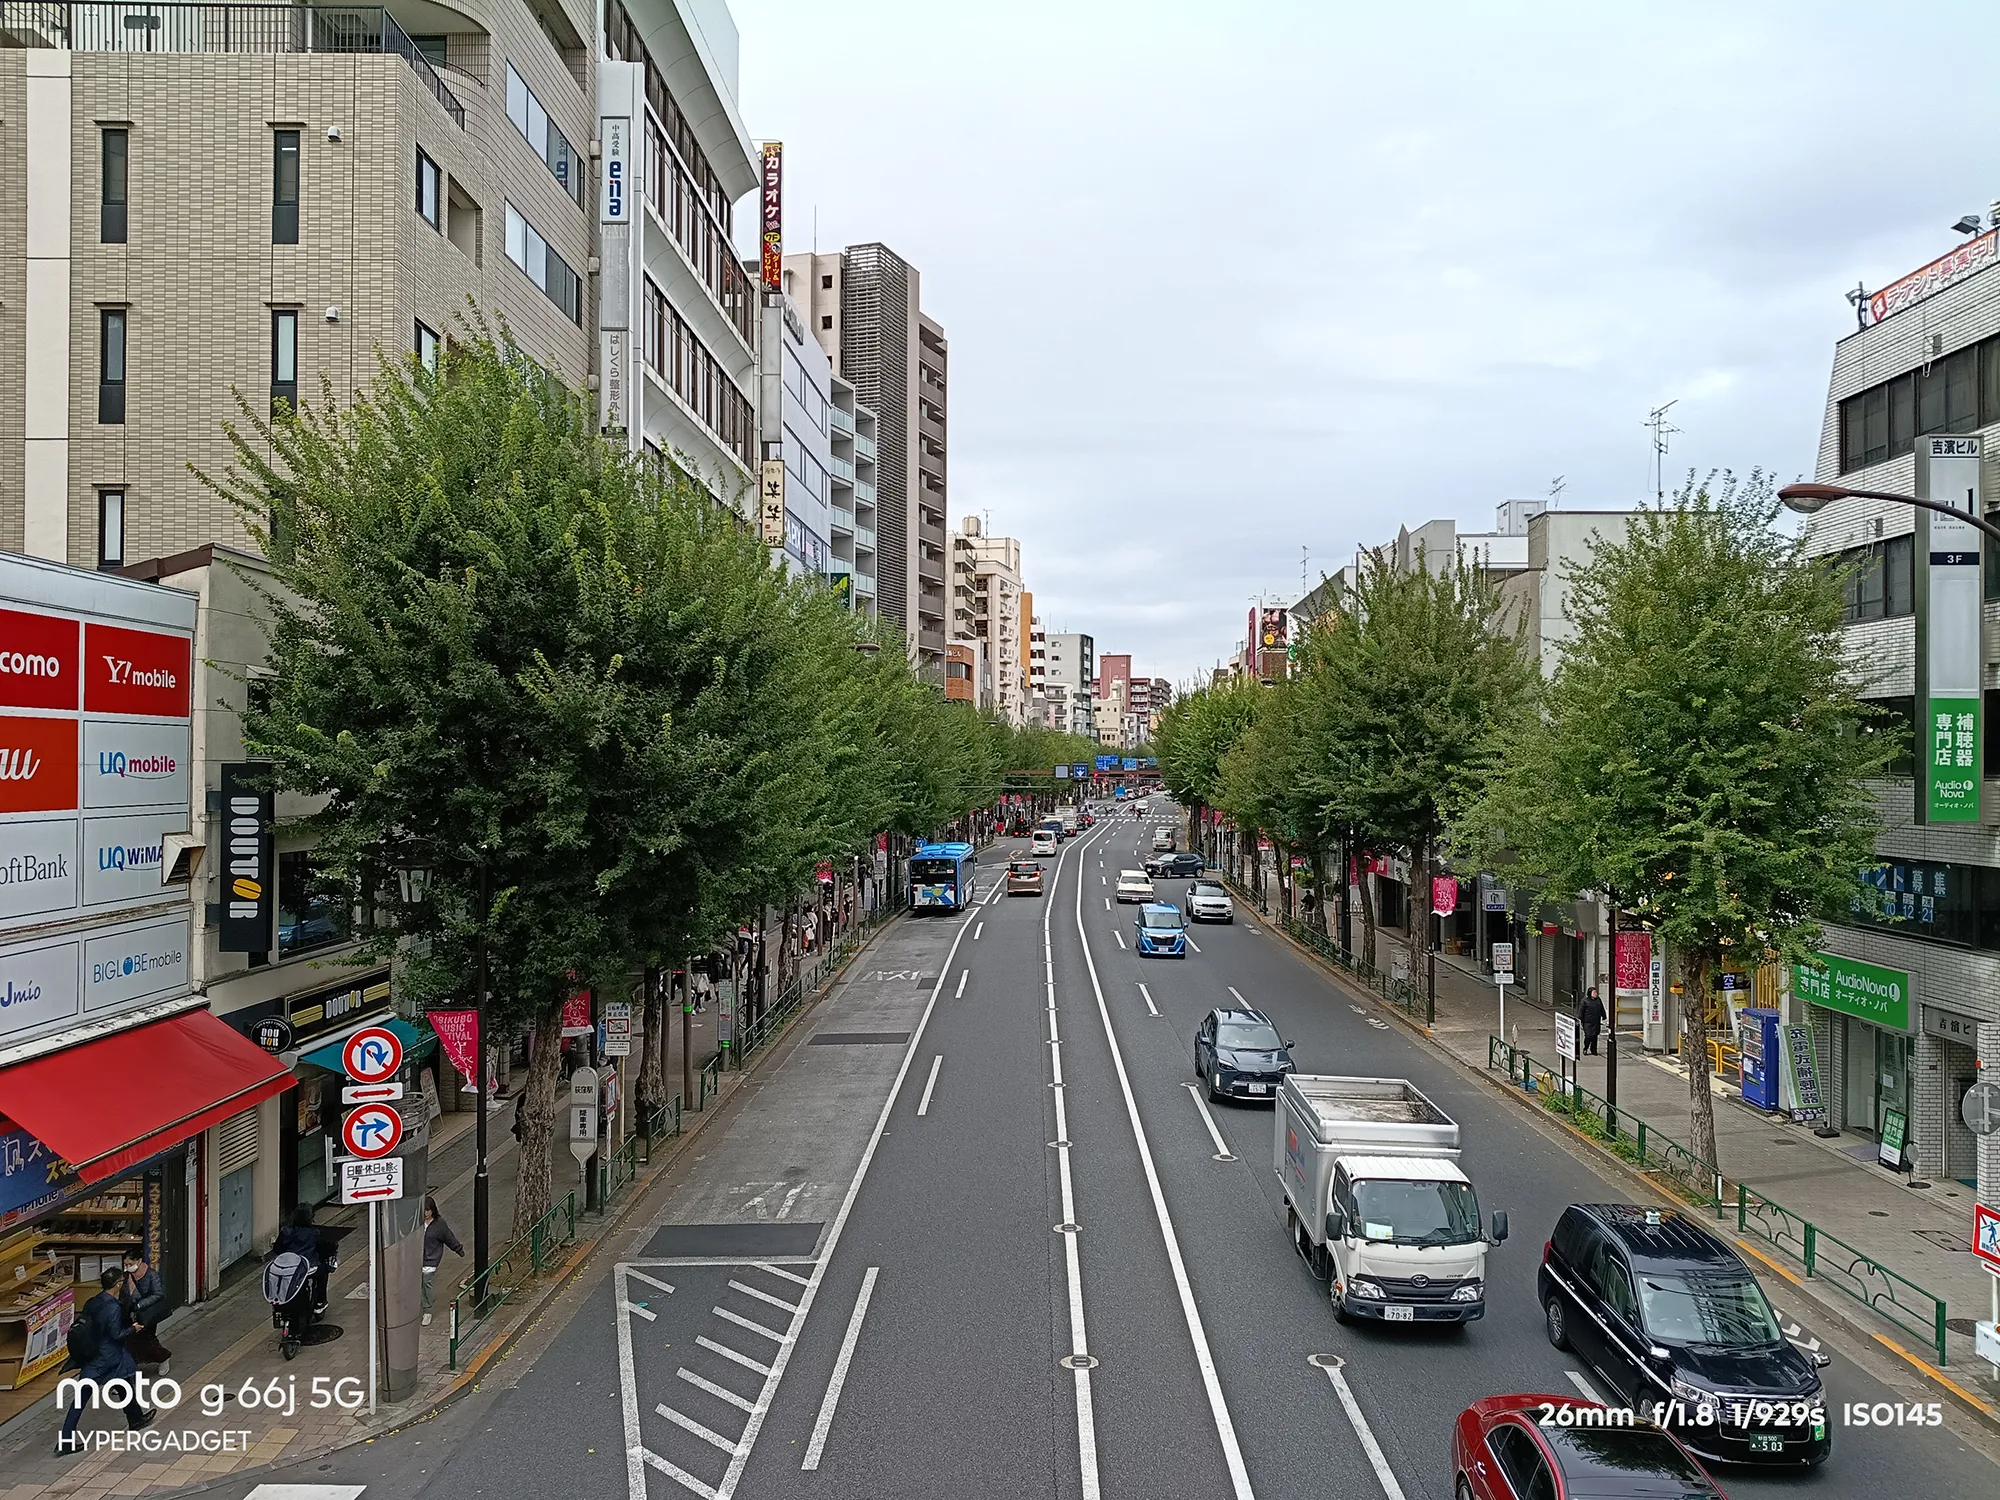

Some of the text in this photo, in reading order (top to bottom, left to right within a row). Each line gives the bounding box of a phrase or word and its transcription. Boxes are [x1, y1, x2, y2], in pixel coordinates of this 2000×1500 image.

[609, 161, 621, 216] ena
[766, 156, 779, 219] カラオケ
[766, 234, 778, 242] 7F
[609, 333, 620, 424] はしくら整形外科
[1932, 440, 1977, 454] 吉濱ビル
[1947, 555, 1962, 563] 3F
[0, 652, 60, 678] como
[1935, 713, 1952, 766] 専門店
[1956, 713, 1974, 767] 補聴器
[100, 752, 176, 777] UQ mobile
[1935, 780, 1962, 790] Audio
[1940, 789, 1964, 798] Nova
[0, 853, 69, 885] oftBank
[99, 845, 163, 871] UQ WiMA
[229, 797, 262, 918] DOUTOR
[93, 950, 182, 983] BIGLOBE mobile
[1723, 973, 1735, 989] 空
[1835, 969, 1888, 998] AudioNova
[326, 989, 361, 1019] DOUTOR
[1835, 988, 1888, 1012] オーディオ・ノバ
[261, 1027, 280, 1037] DOU
[446, 1031, 473, 1041] TIVAL
[1939, 1017, 1978, 1036] 吉濱ビ
[347, 1162, 398, 1176] 日曜・休日を除く
[352, 1177, 360, 1188] 7
[386, 1174, 394, 1184] 9
